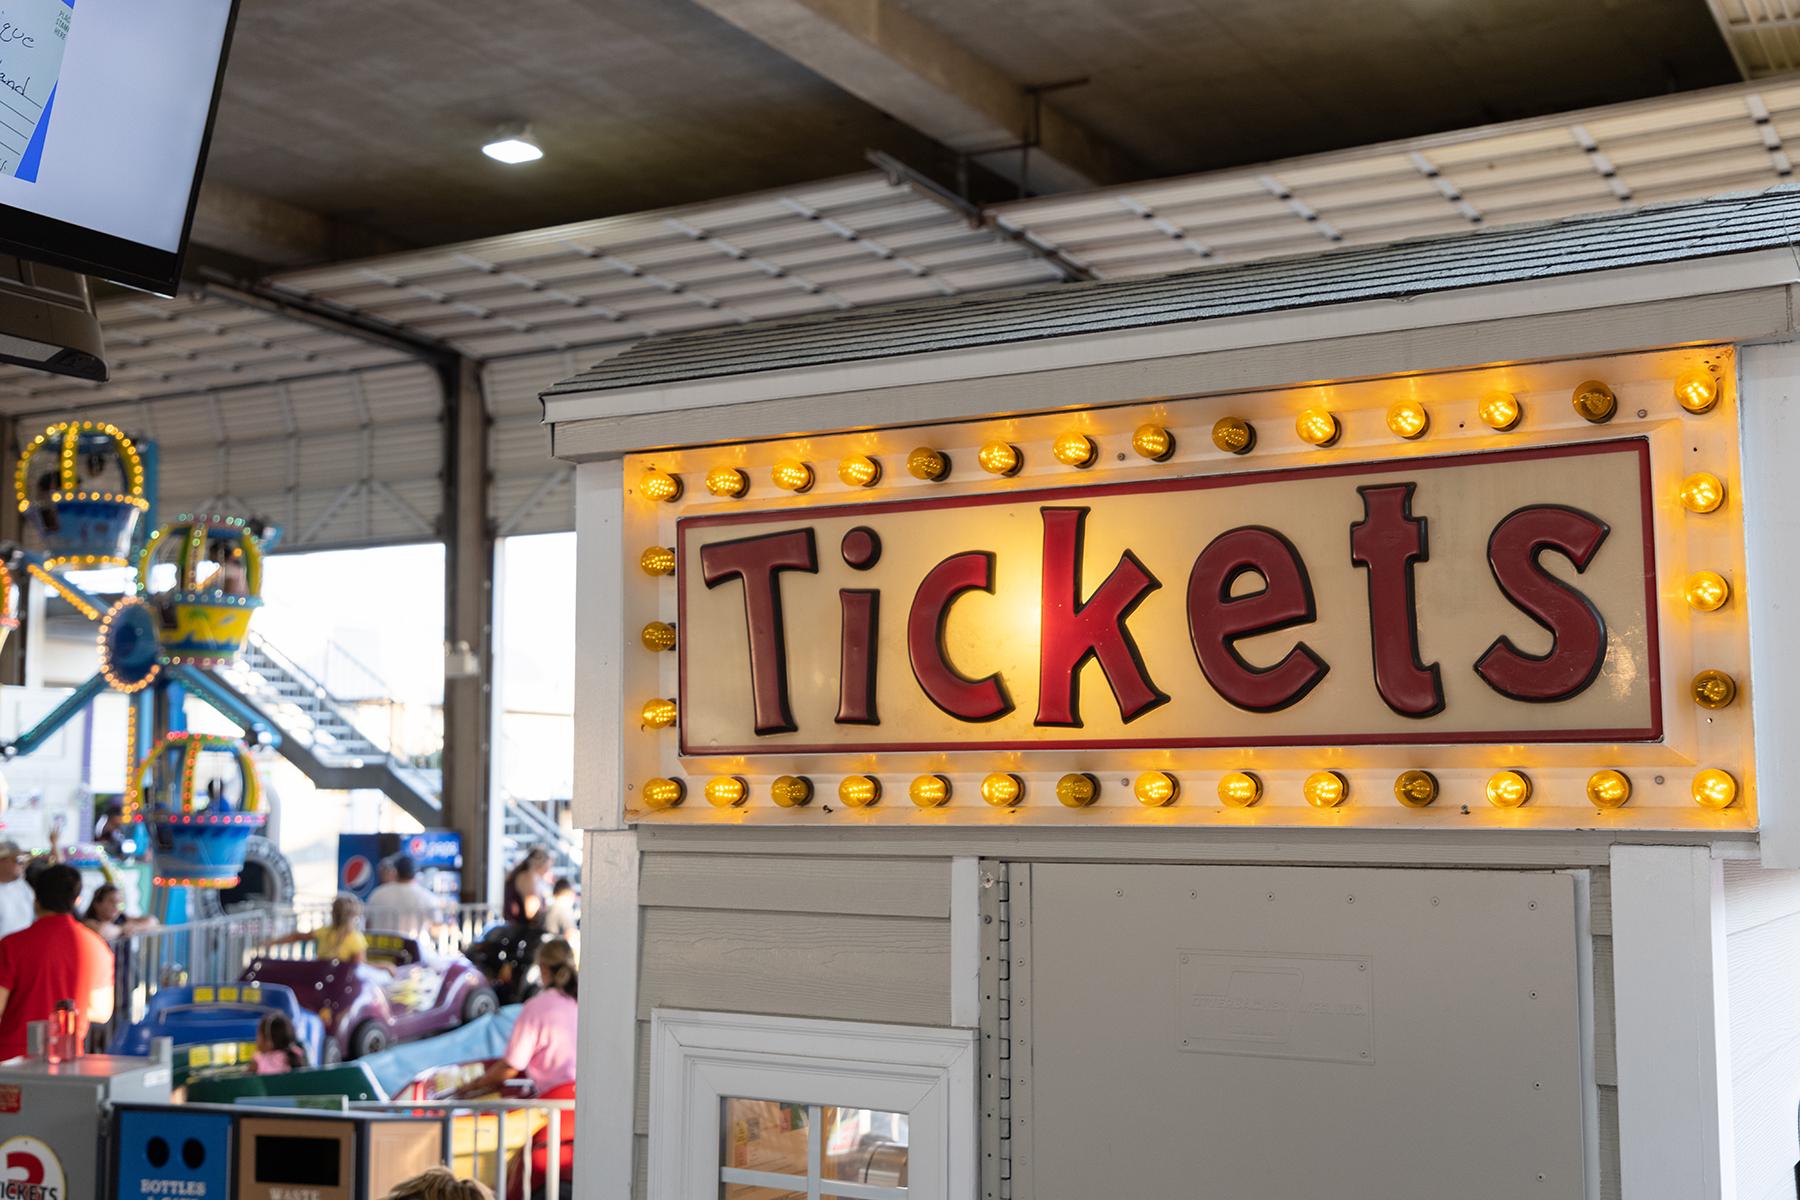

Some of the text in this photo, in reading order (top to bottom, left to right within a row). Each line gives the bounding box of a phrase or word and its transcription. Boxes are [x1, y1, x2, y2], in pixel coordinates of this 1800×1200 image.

[0, 22, 35, 48] que
[0, 72, 31, 96] and
[701, 482, 1610, 735] Tickets
[0, 1182, 58, 1200] ICKETS
